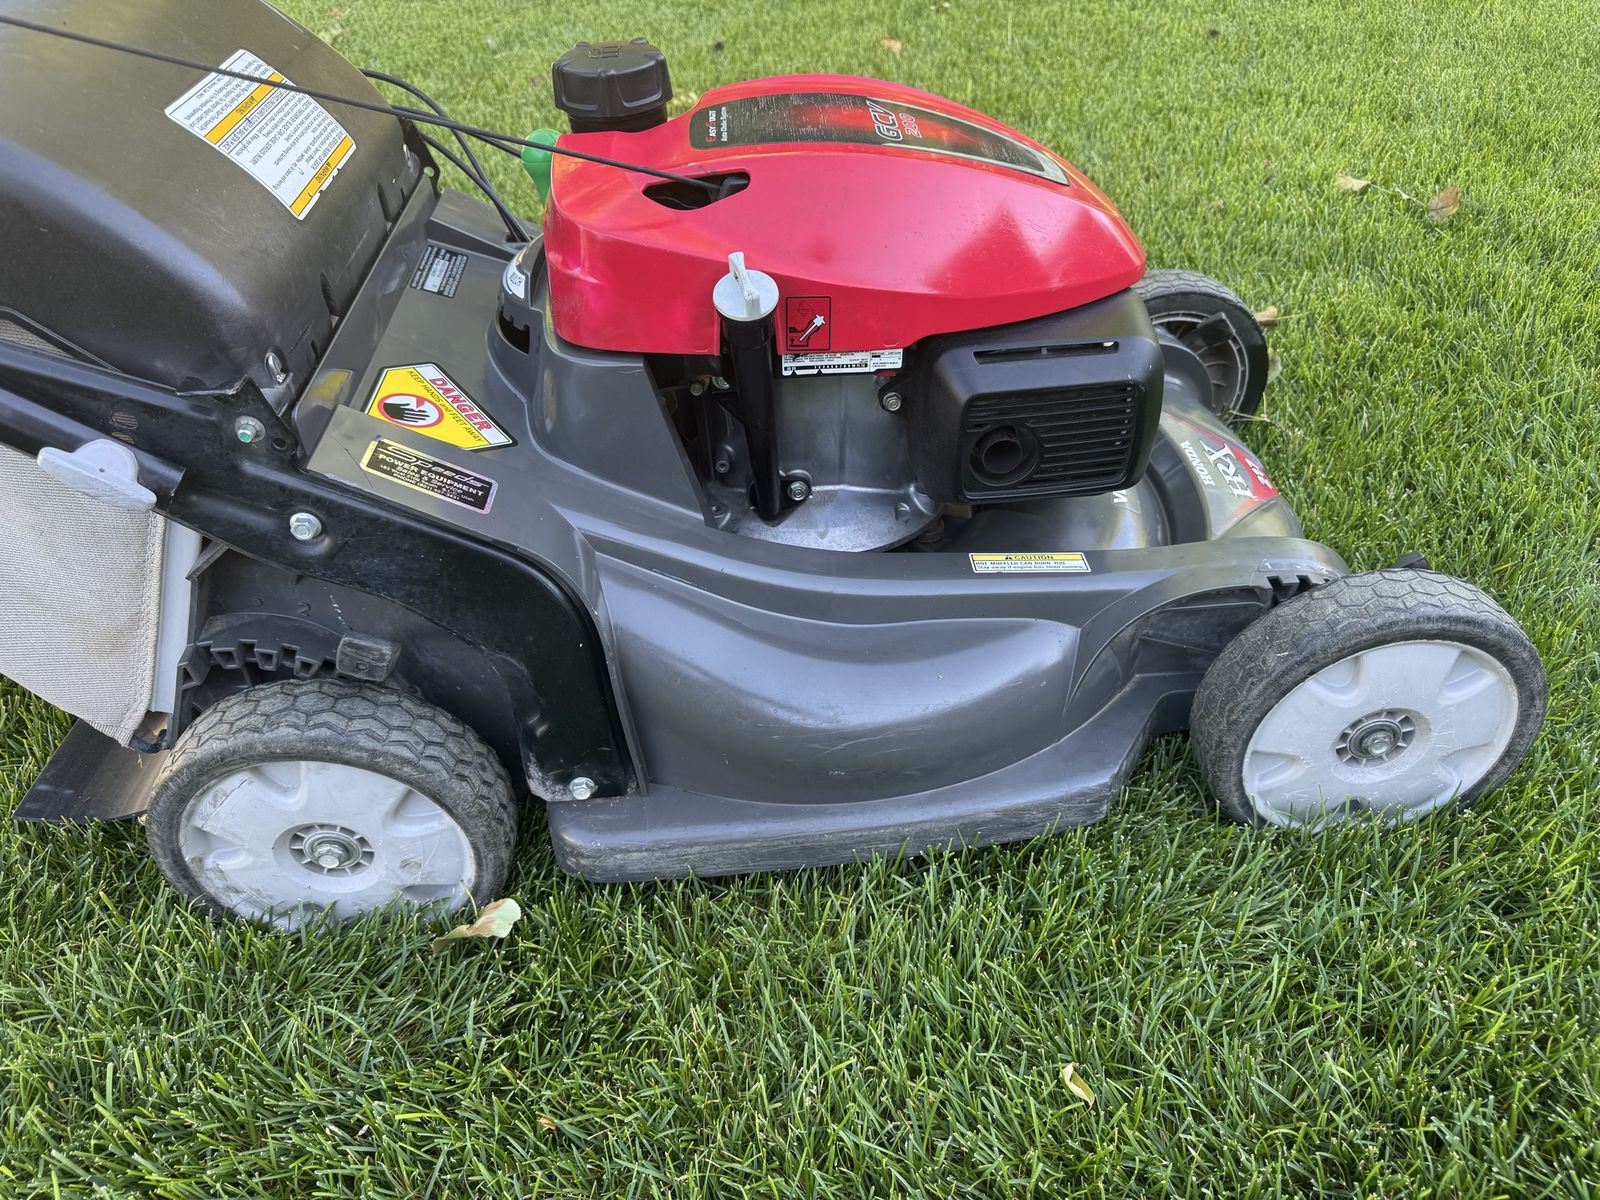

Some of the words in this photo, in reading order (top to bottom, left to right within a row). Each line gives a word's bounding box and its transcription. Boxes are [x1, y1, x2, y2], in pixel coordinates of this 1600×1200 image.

[235, 98, 254, 115] WARNING
[866, 100, 902, 141] GCV
[904, 113, 922, 139] 200
[315, 166, 330, 183] WARNING
[407, 370, 424, 387] KEEP
[421, 384, 442, 402] HANDS
[450, 411, 466, 428] FEET
[464, 426, 483, 442] AWAY
[429, 377, 492, 432] DANGER
[377, 445, 489, 486] Speeds
[378, 454, 419, 472] POWER
[420, 469, 484, 496] EQUIPMENT
[392, 473, 416, 484] PHONE
[395, 465, 420, 478] Sales
[430, 478, 463, 493] Service
[1180, 440, 1216, 486] HONDA
[1200, 440, 1257, 501] HRX
